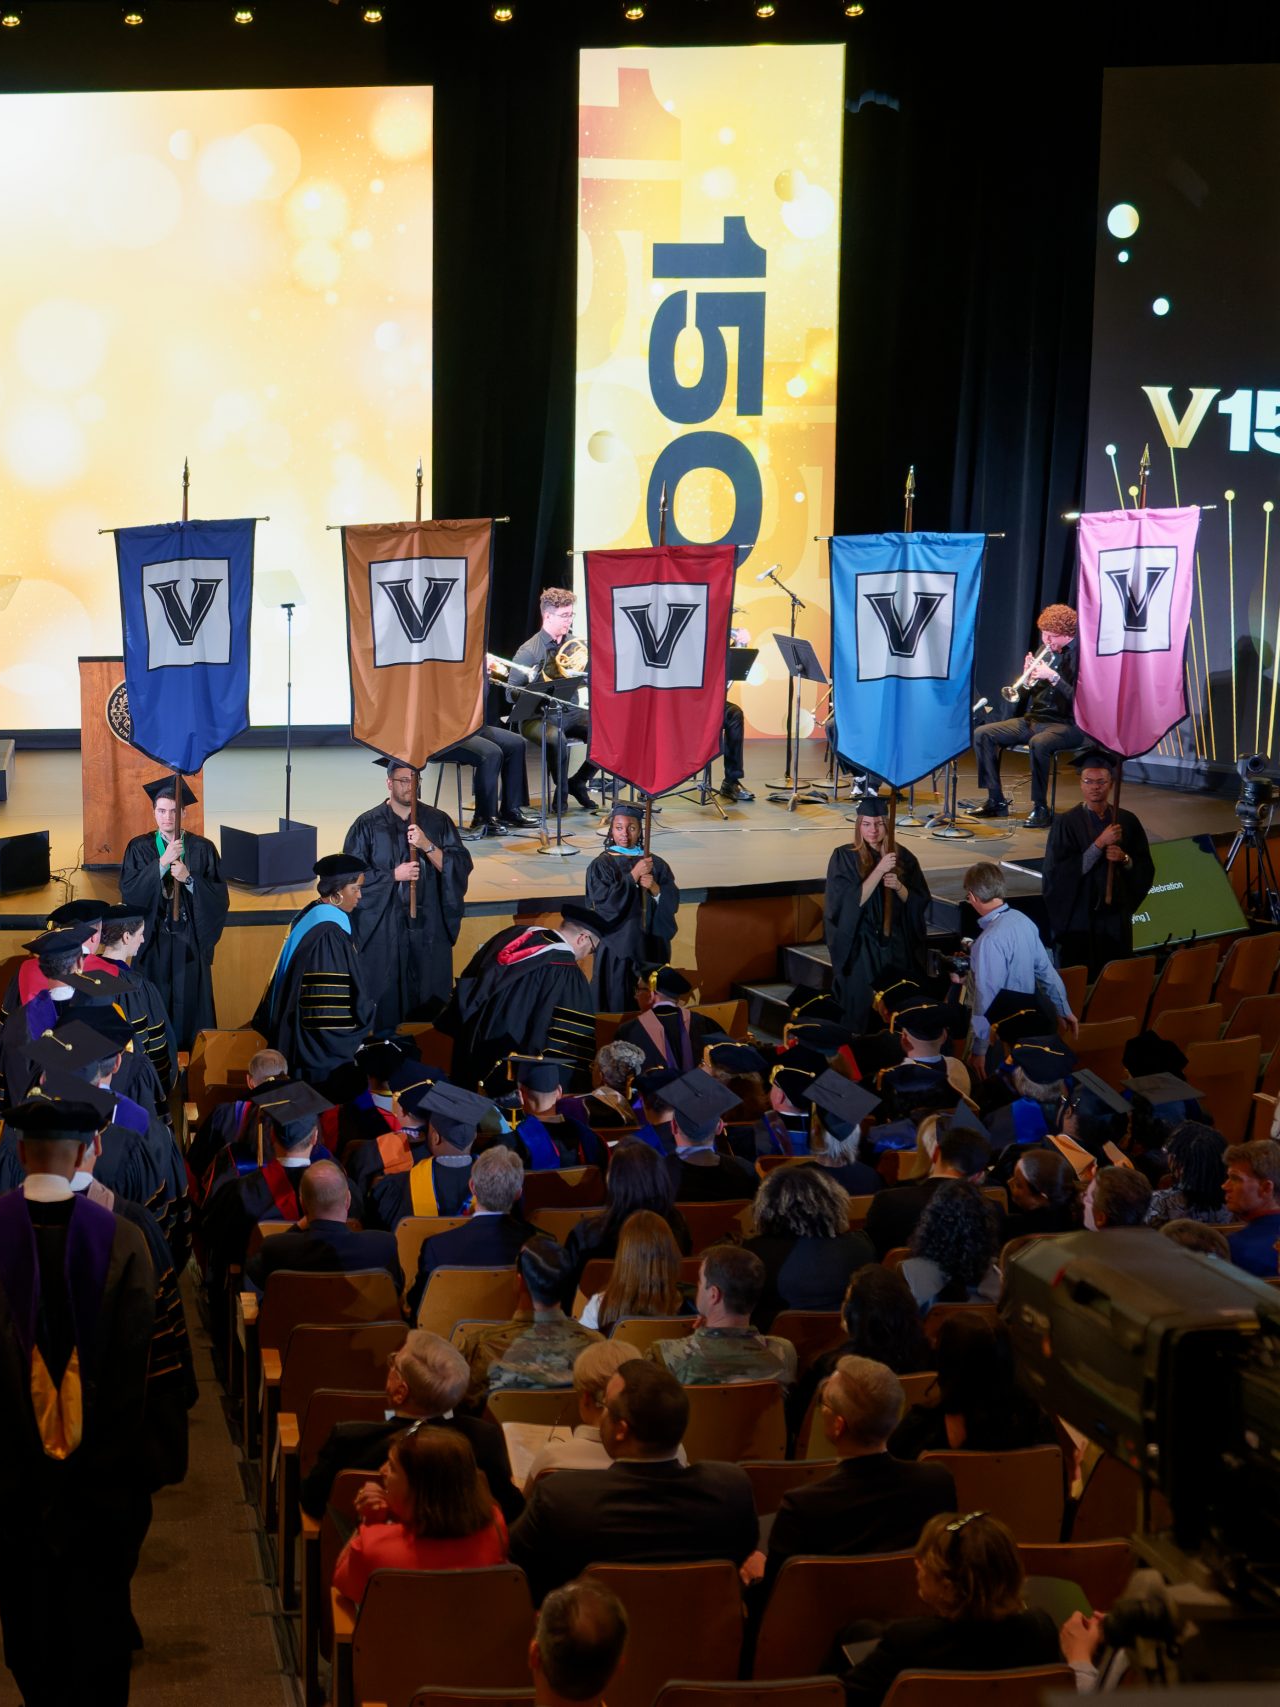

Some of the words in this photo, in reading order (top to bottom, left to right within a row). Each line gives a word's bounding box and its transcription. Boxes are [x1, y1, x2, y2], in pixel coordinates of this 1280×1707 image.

[647, 215, 767, 569] 150
[147, 578, 223, 645] V
[376, 577, 459, 643] V
[863, 591, 948, 658] V
[1105, 567, 1170, 632] V
[620, 603, 701, 669] V
